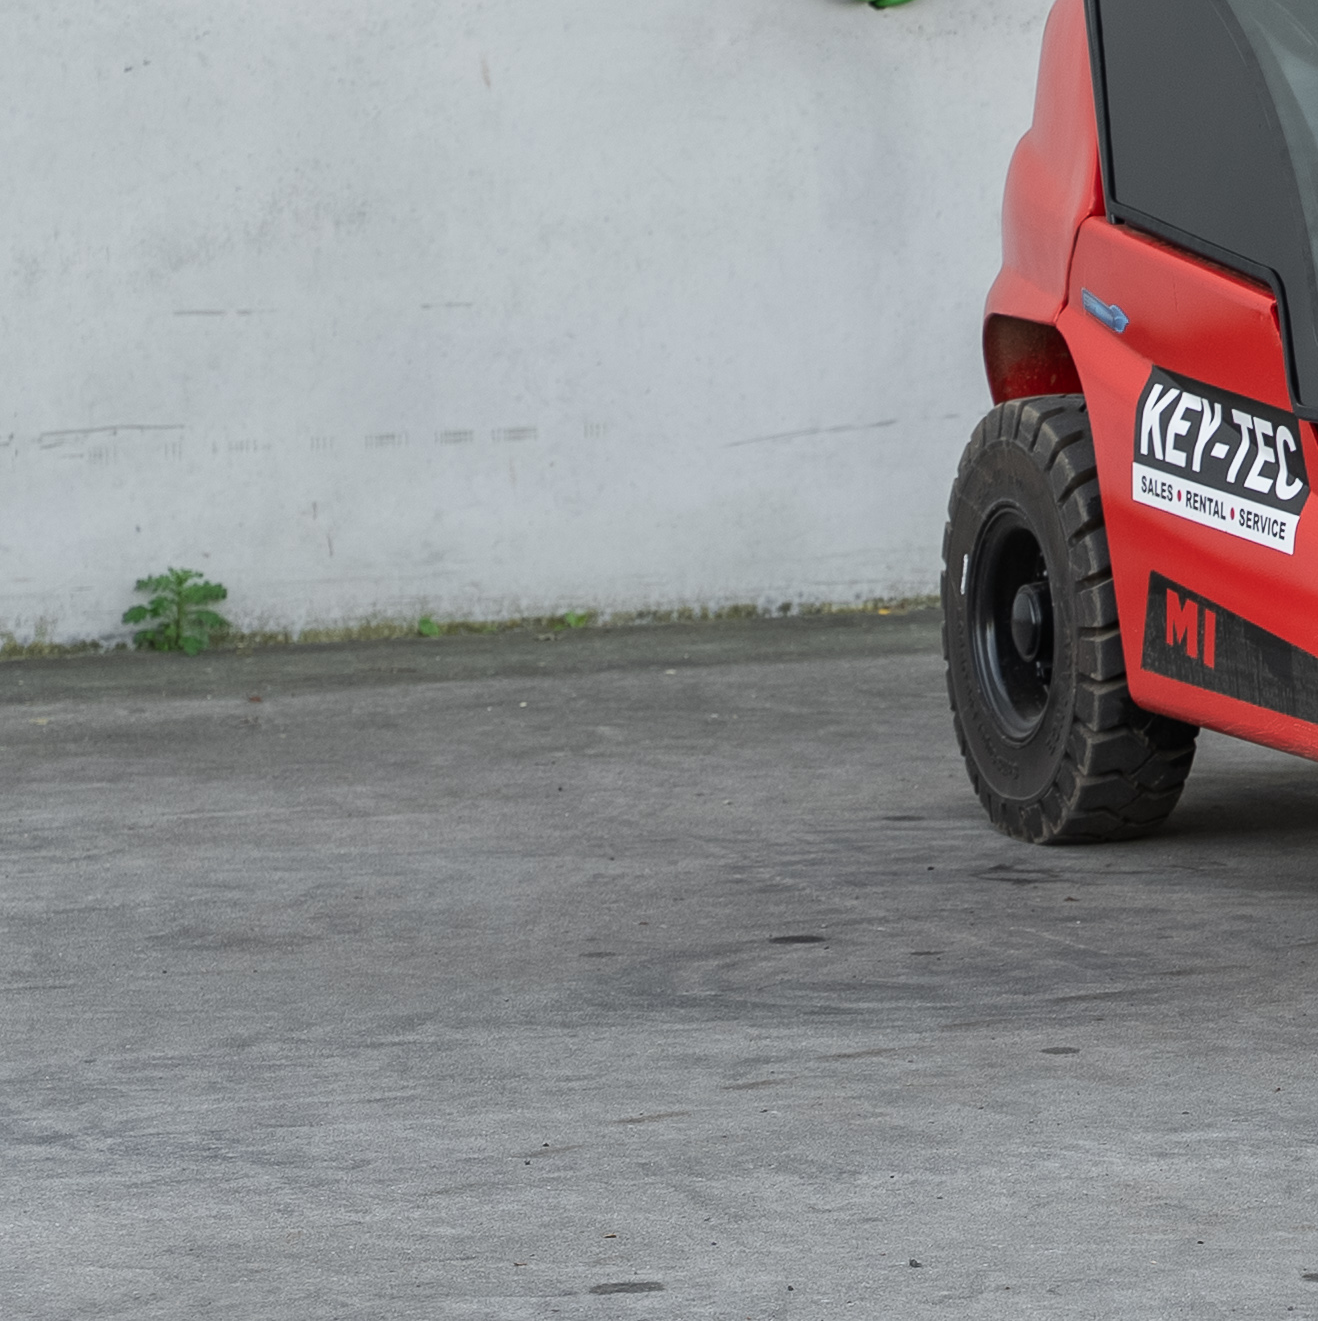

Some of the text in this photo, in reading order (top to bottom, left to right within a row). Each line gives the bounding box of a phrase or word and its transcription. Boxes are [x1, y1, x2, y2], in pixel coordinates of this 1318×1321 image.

[1140, 383, 1304, 501] KEY-TEC
[1141, 475, 1287, 541] SALES RENTAL SERVICE
[1165, 587, 1216, 670] MI
